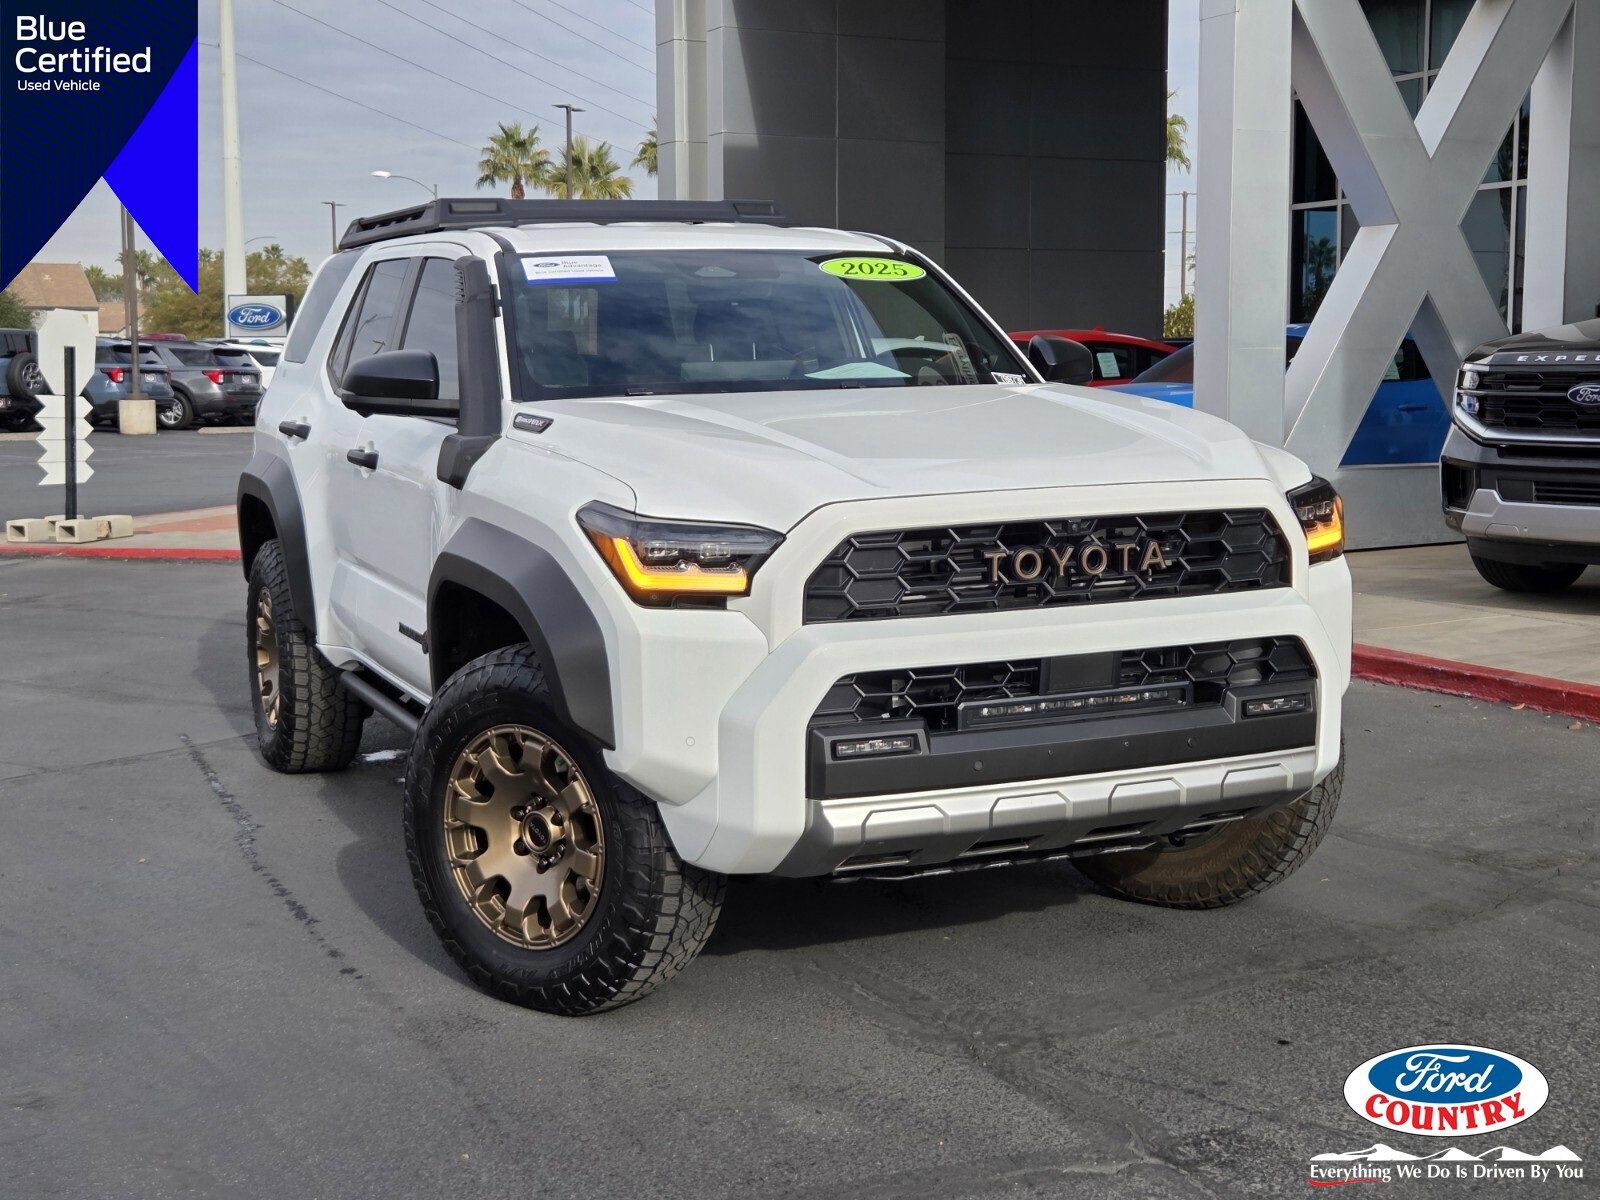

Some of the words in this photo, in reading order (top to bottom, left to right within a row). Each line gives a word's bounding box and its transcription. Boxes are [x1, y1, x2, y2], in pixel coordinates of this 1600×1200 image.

[840, 262, 908, 276] 2025
[238, 307, 271, 324] Ford
[984, 540, 1167, 582] TOYOTA
